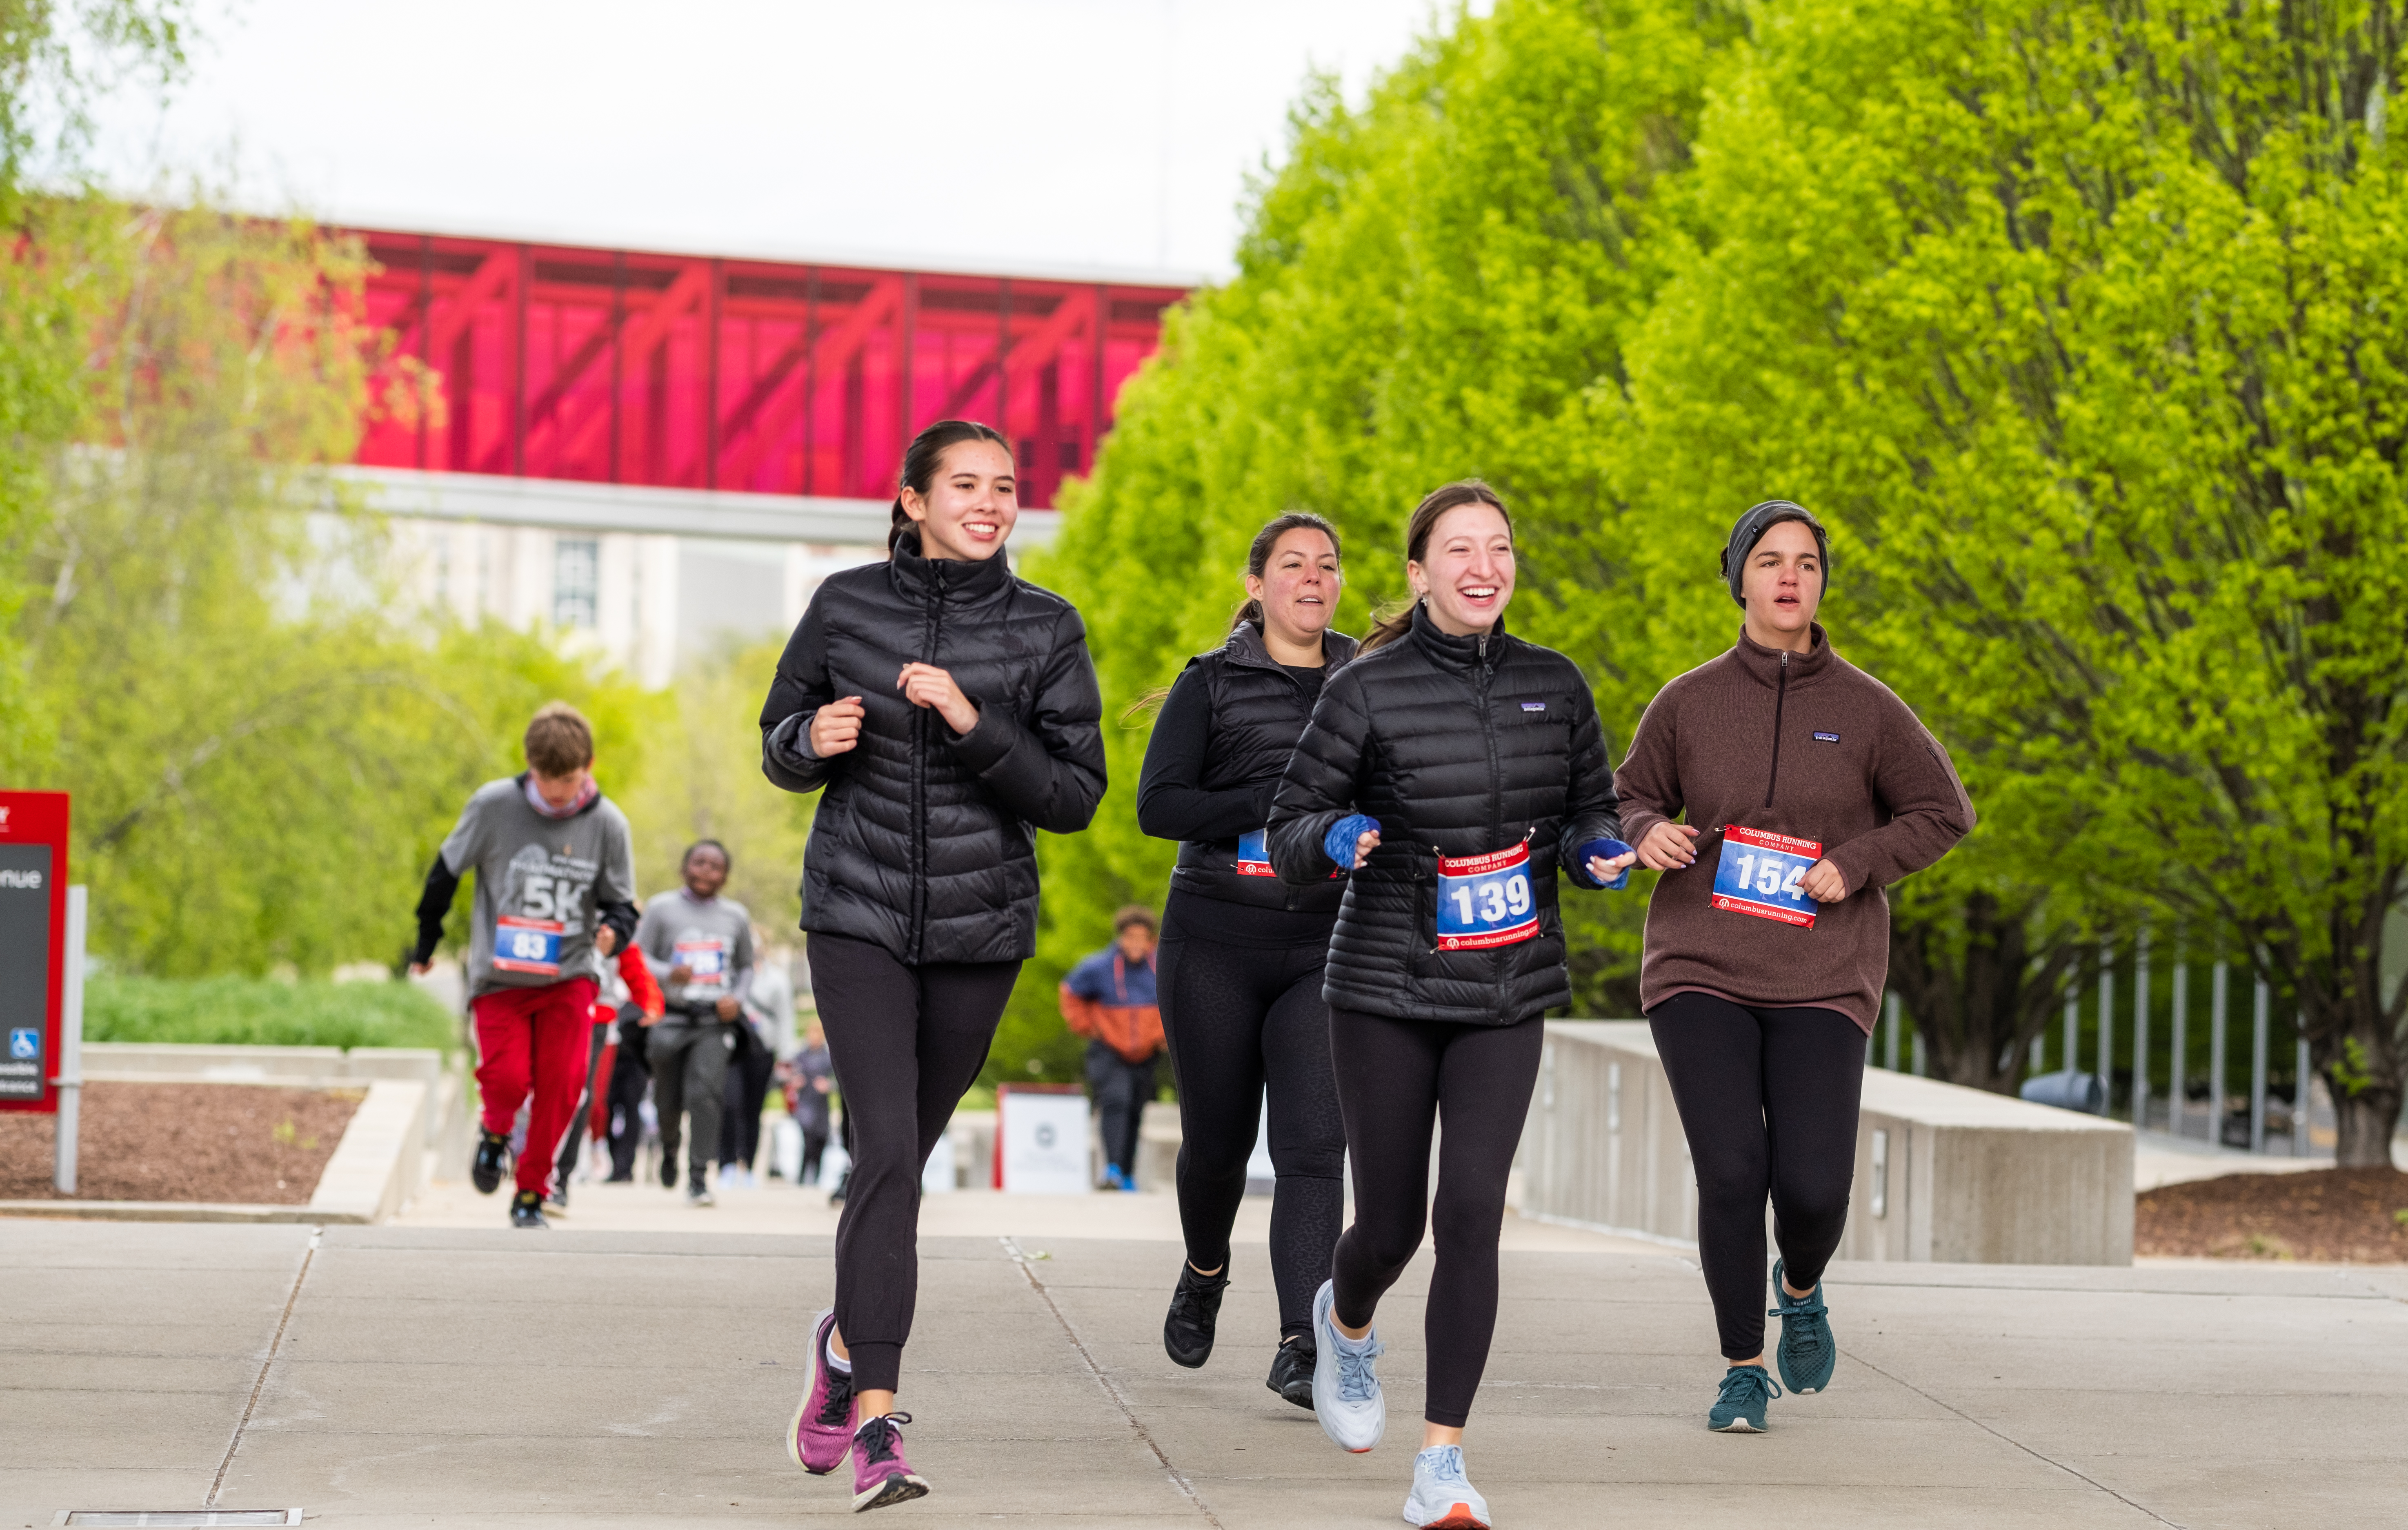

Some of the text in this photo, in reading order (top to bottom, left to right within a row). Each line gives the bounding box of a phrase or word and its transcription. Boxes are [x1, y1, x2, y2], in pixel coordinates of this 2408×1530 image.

[1739, 828, 1817, 849] COLUMBUS RUNNING
[1759, 840, 1794, 851] COMPANY
[1445, 844, 1523, 867] COLUMBUS RUNNING
[1468, 860, 1507, 873] COMPANY
[1737, 854, 1807, 901] 154
[522, 876, 590, 922] 5K
[1451, 874, 1530, 924] 139
[1730, 903, 1808, 923] columbusrunning.com
[513, 932, 547, 960] 83
